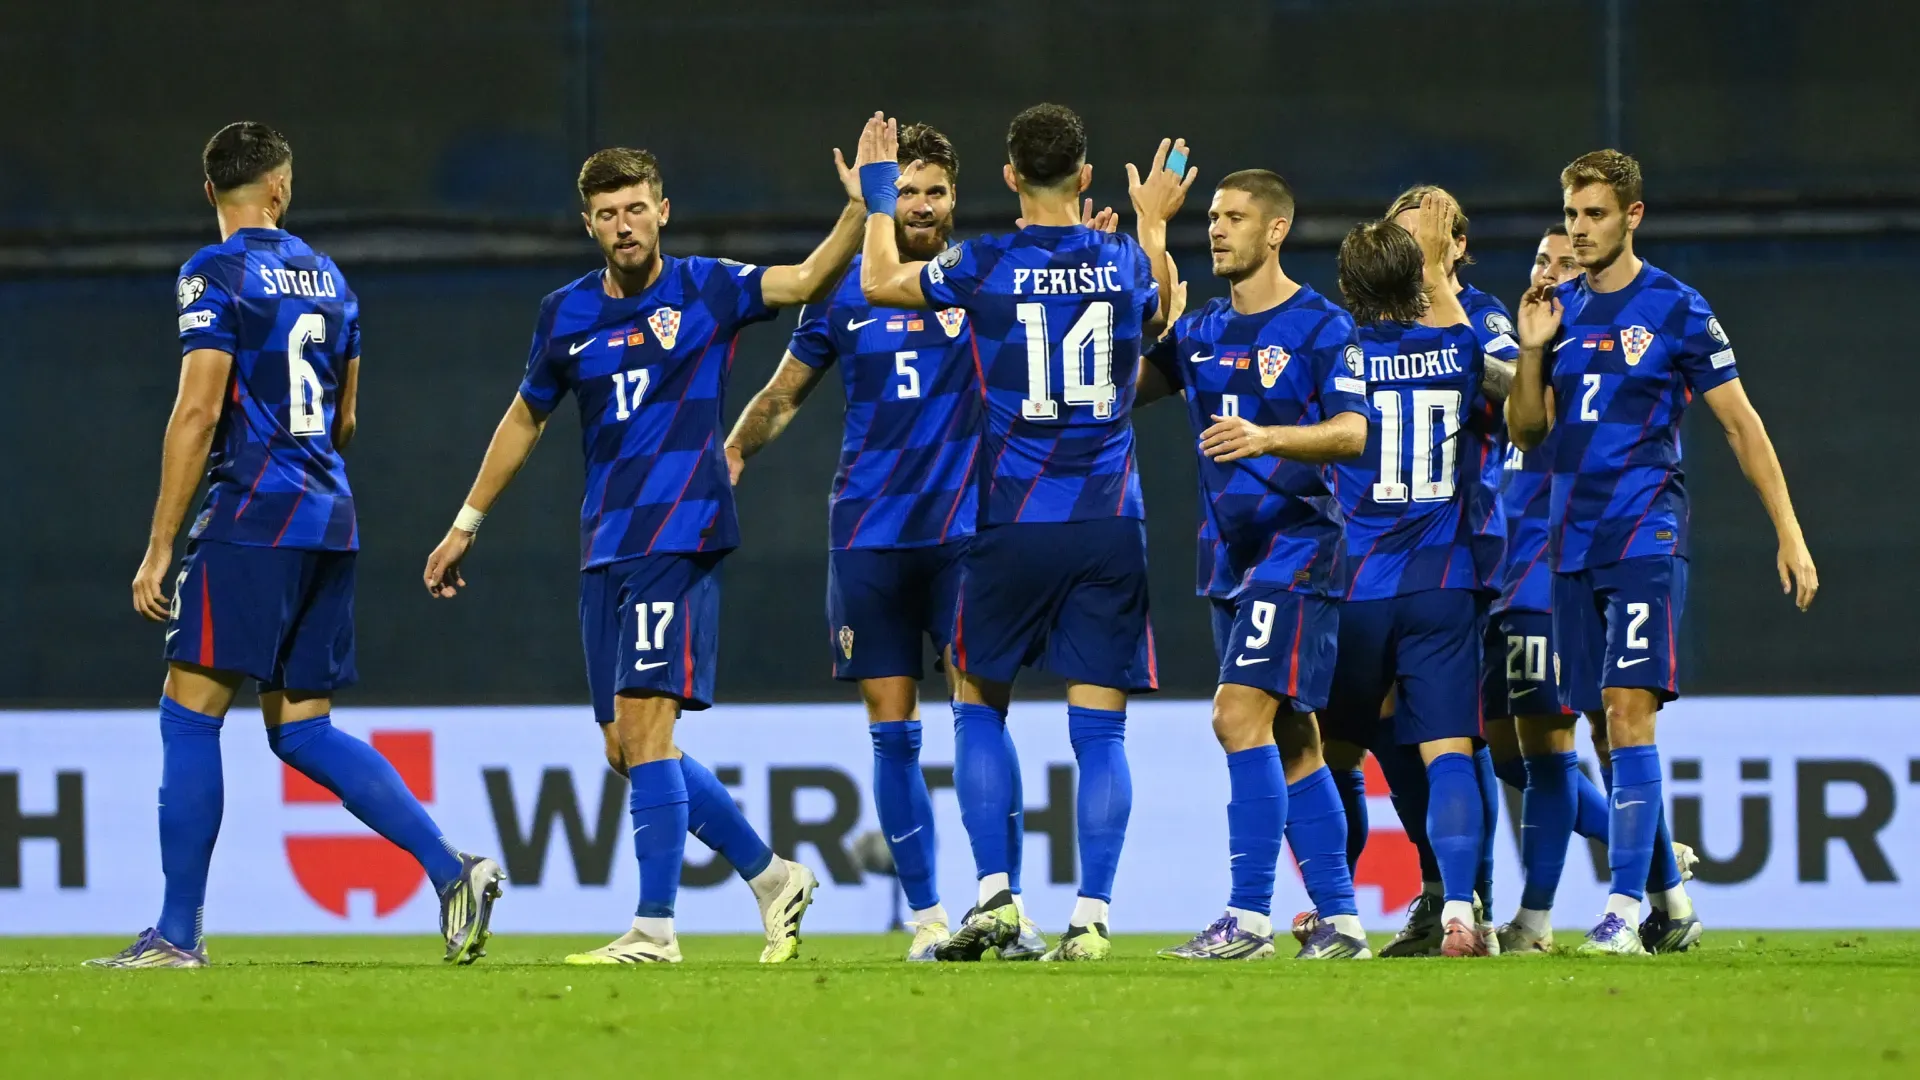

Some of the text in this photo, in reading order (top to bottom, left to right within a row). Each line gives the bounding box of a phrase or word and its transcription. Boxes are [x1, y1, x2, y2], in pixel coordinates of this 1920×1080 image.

[1013, 260, 1122, 295] PERIŠIĆ
[288, 313, 326, 437] 6
[895, 350, 921, 399] 5
[1016, 301, 1117, 420] 14
[1369, 342, 1463, 382] MODRIĆ
[611, 368, 650, 422] 17
[1580, 373, 1602, 422] 2
[1372, 389, 1463, 504] 10
[634, 601, 675, 651] 17
[1245, 600, 1277, 650] 9
[1626, 602, 1650, 650] 2
[1506, 635, 1548, 681] 20
